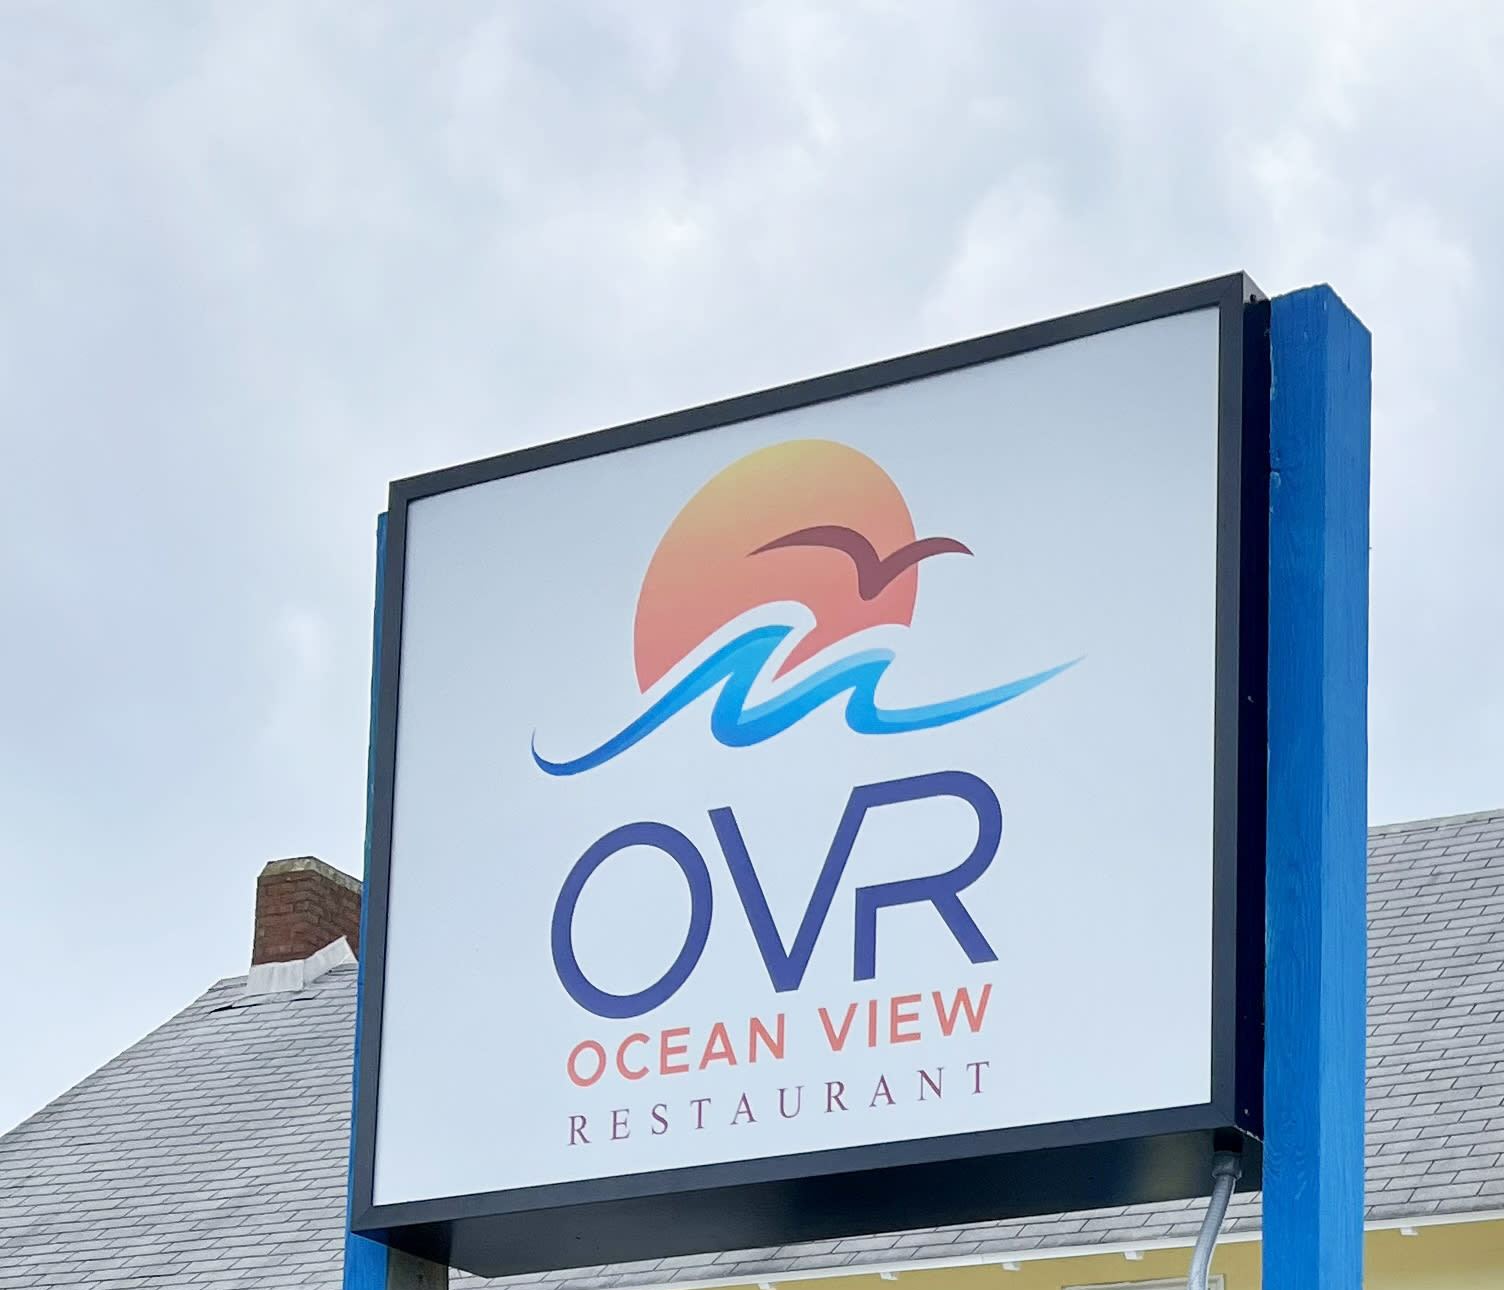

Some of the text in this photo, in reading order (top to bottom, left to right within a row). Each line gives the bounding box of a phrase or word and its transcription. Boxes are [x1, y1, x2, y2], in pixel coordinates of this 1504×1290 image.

[551, 770, 1003, 1019] OVR
[567, 983, 993, 1087] OCEAN VIEW
[568, 1060, 991, 1146] RESTAURANT
